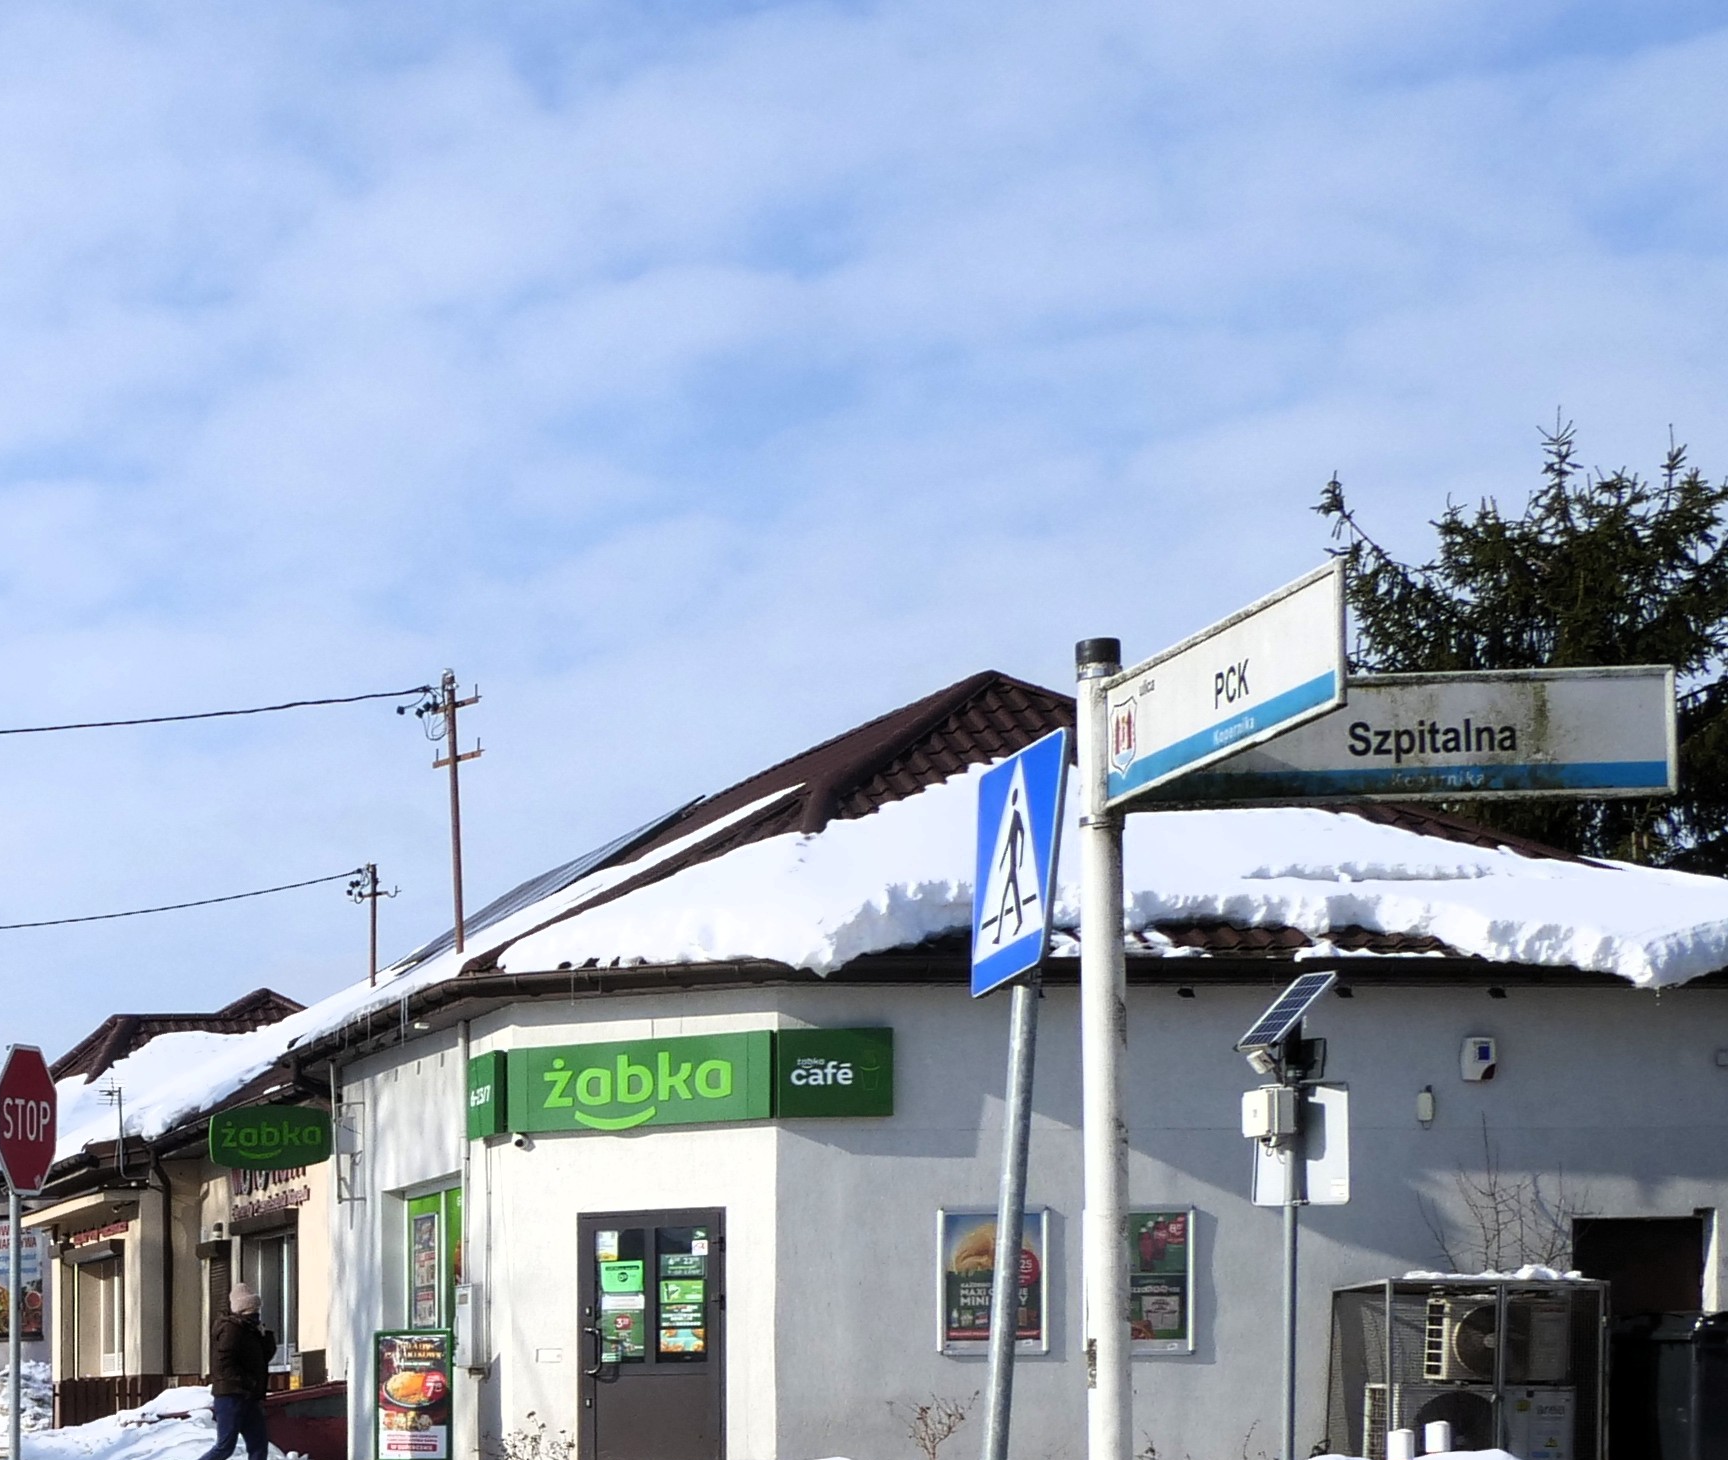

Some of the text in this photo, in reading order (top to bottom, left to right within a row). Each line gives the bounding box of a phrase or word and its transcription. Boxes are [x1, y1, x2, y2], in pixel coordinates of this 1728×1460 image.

[1139, 679, 1155, 696] ulica
[1214, 658, 1249, 709] PCK
[1348, 718, 1517, 763] Szpitalna
[544, 1052, 733, 1109] żabka
[3, 1098, 51, 1142] STOP
[220, 1120, 322, 1149] żabka
